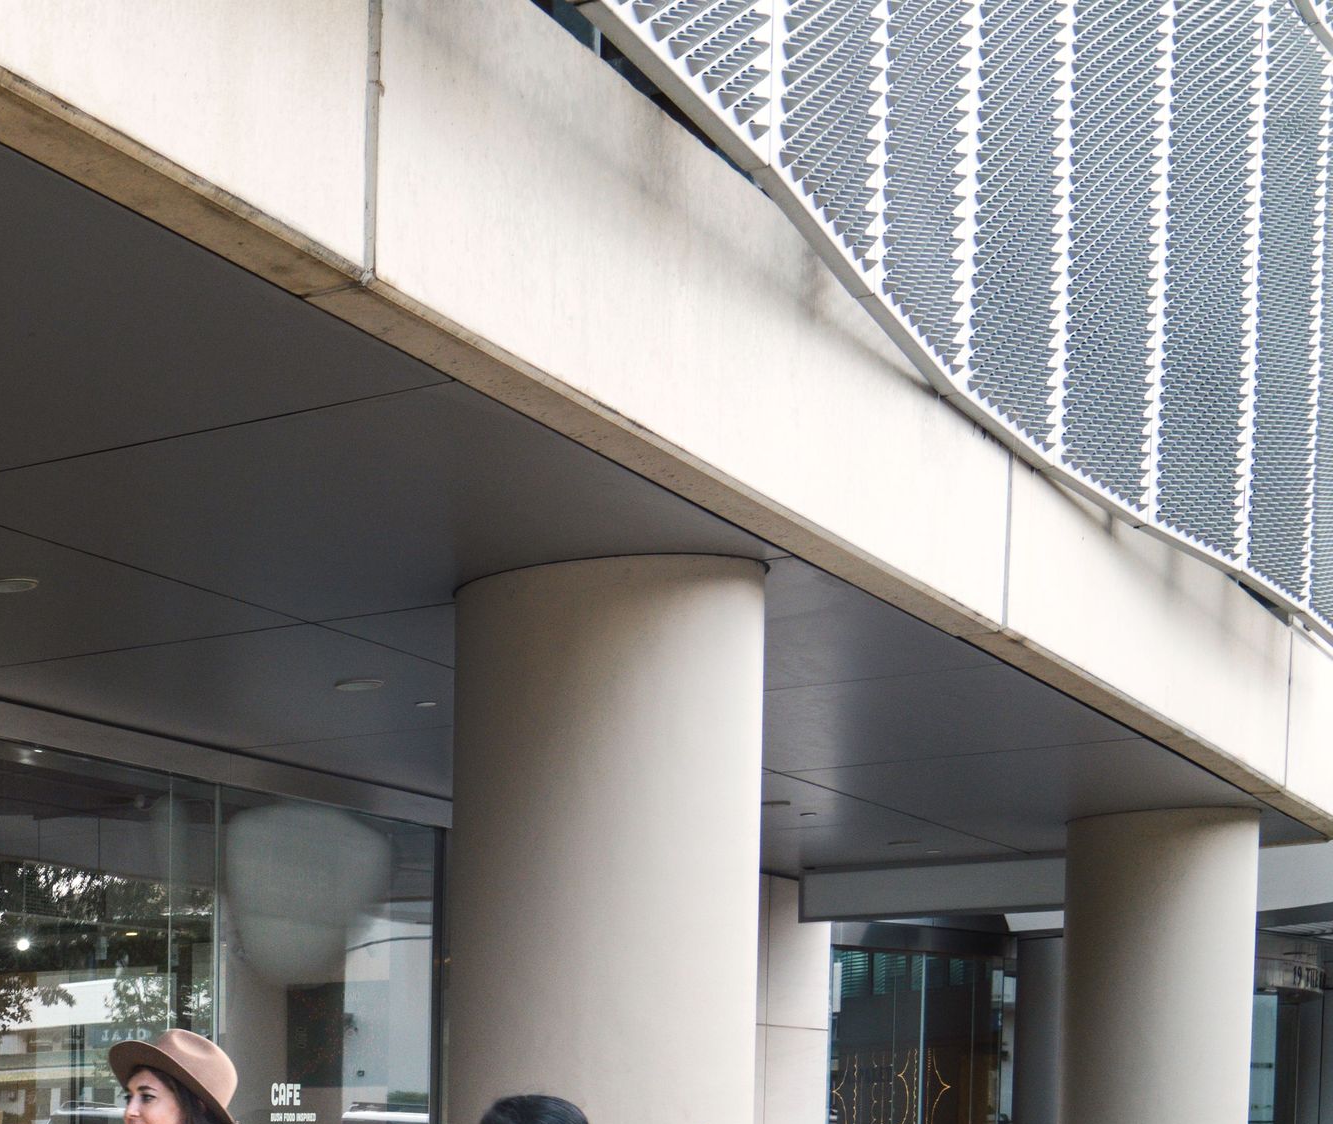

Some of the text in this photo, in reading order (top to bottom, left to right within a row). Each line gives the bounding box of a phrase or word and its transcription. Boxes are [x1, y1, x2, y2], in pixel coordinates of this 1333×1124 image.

[271, 1083, 301, 1106] CAFE
[270, 1112, 283, 1122] BUSH
[283, 1112, 295, 1122] FOOD
